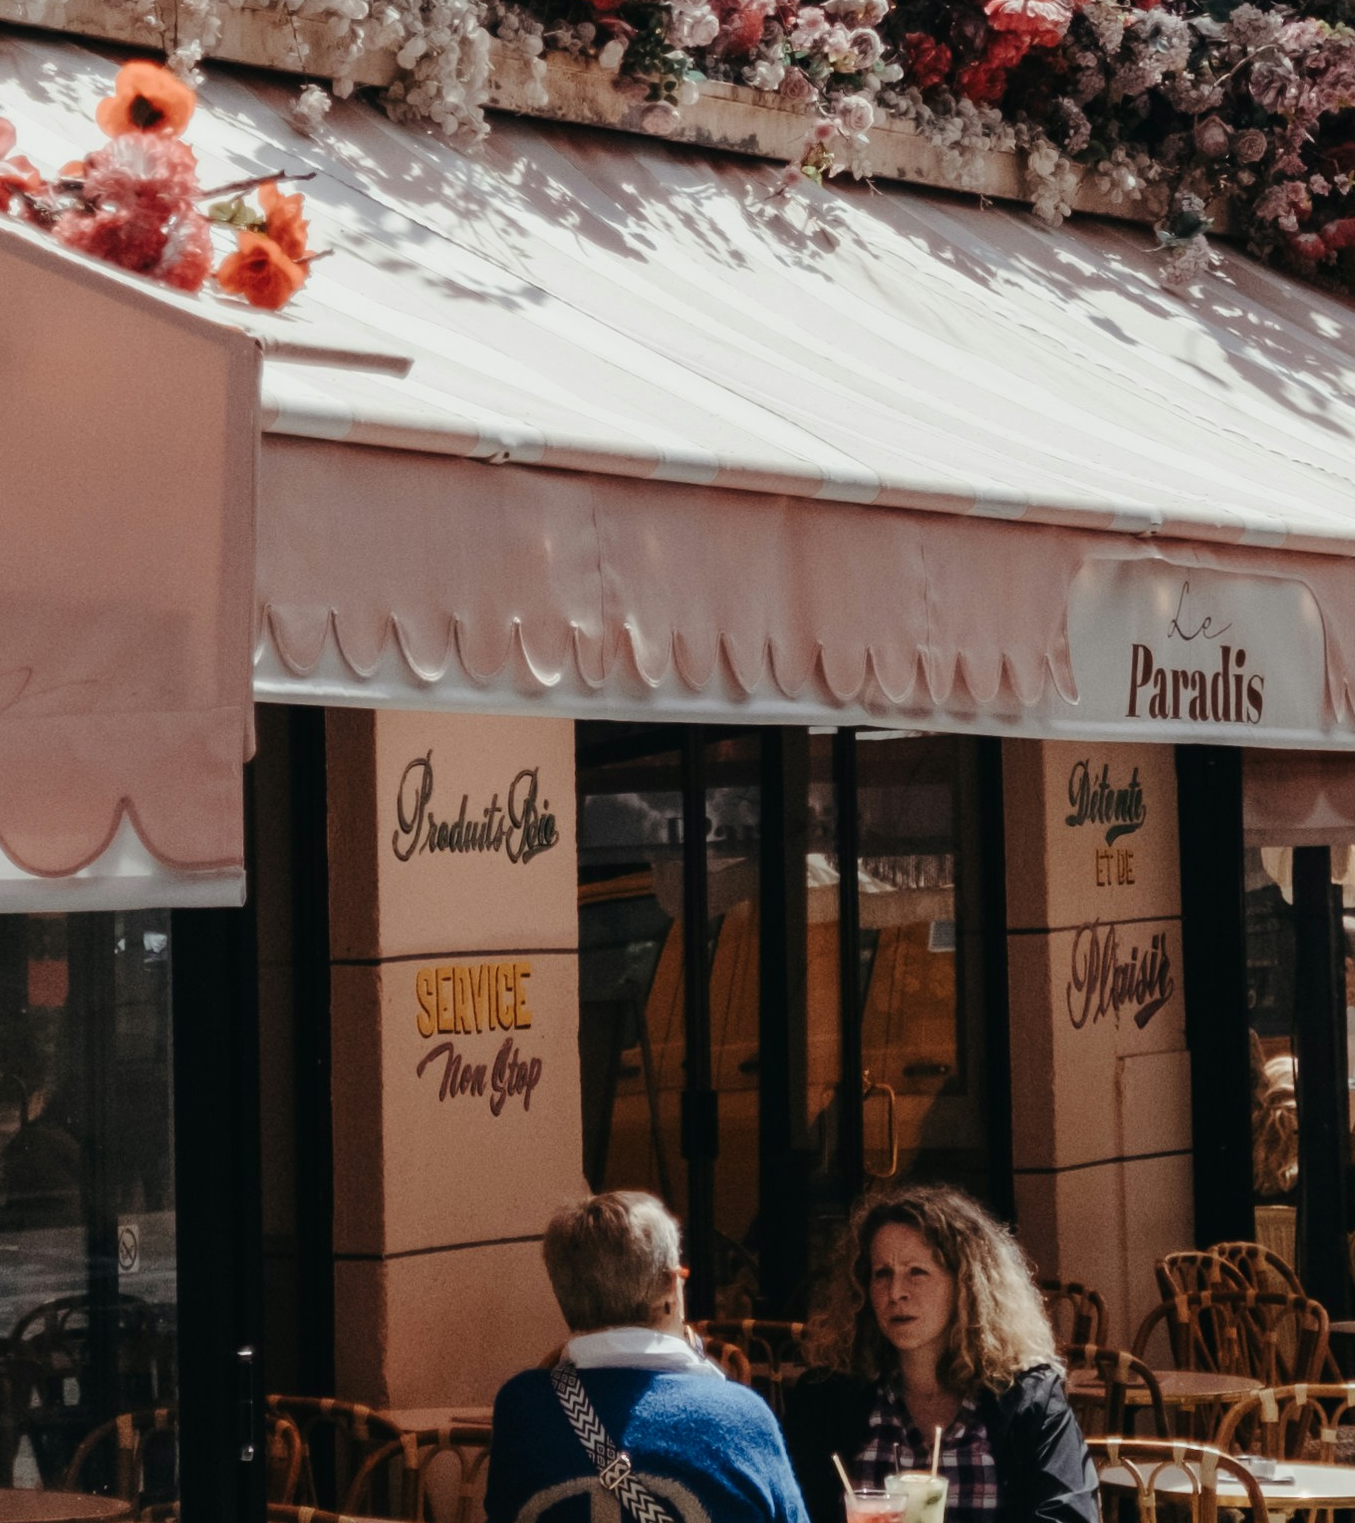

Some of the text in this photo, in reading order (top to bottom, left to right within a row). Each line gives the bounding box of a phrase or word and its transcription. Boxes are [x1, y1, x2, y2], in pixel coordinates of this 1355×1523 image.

[1167, 580, 1233, 641] Le
[1124, 643, 1265, 725] Paradis
[392, 748, 506, 862] Produits
[1065, 758, 1147, 847] Détente
[1096, 849, 1136, 887] ET DE
[416, 962, 533, 1038] SERVICE
[1066, 917, 1174, 1031] Plaisir
[416, 1037, 543, 1118] Non Stop
